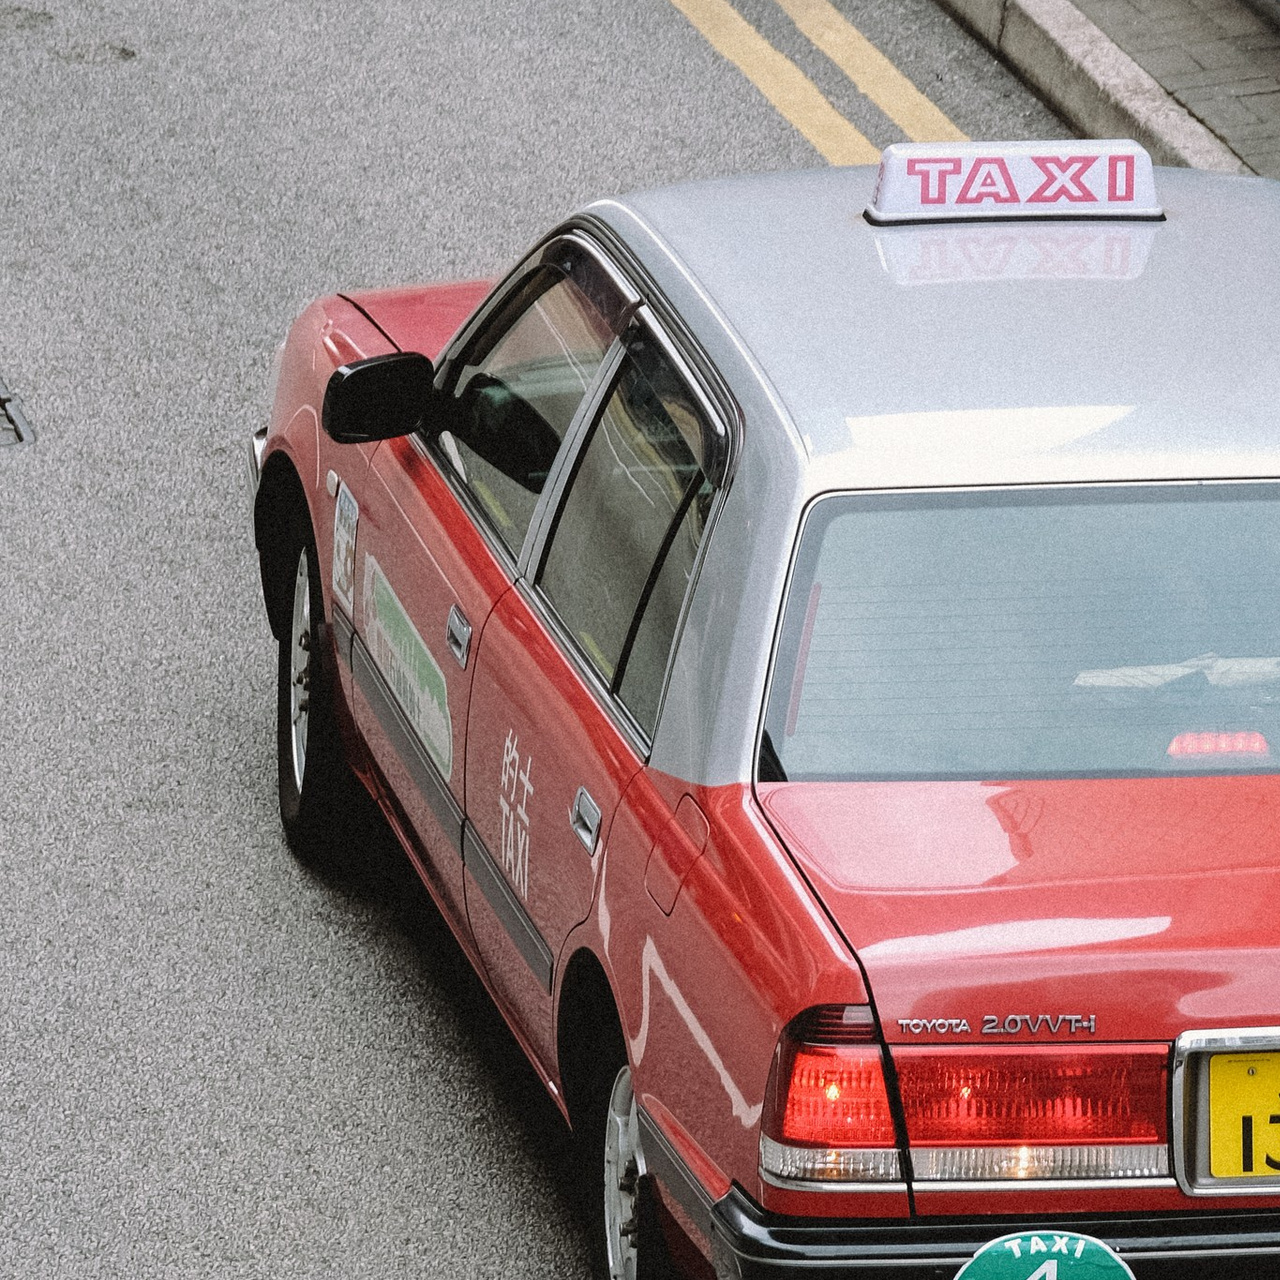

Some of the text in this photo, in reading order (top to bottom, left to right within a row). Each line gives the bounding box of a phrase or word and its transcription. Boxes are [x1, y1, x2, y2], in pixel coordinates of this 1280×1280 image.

[907, 155, 1135, 205] TAXI
[501, 728, 534, 828] 的士
[500, 793, 530, 902] TAXI
[898, 1019, 971, 1034] TOYOTA
[1004, 1235, 1086, 1259] TAXI
